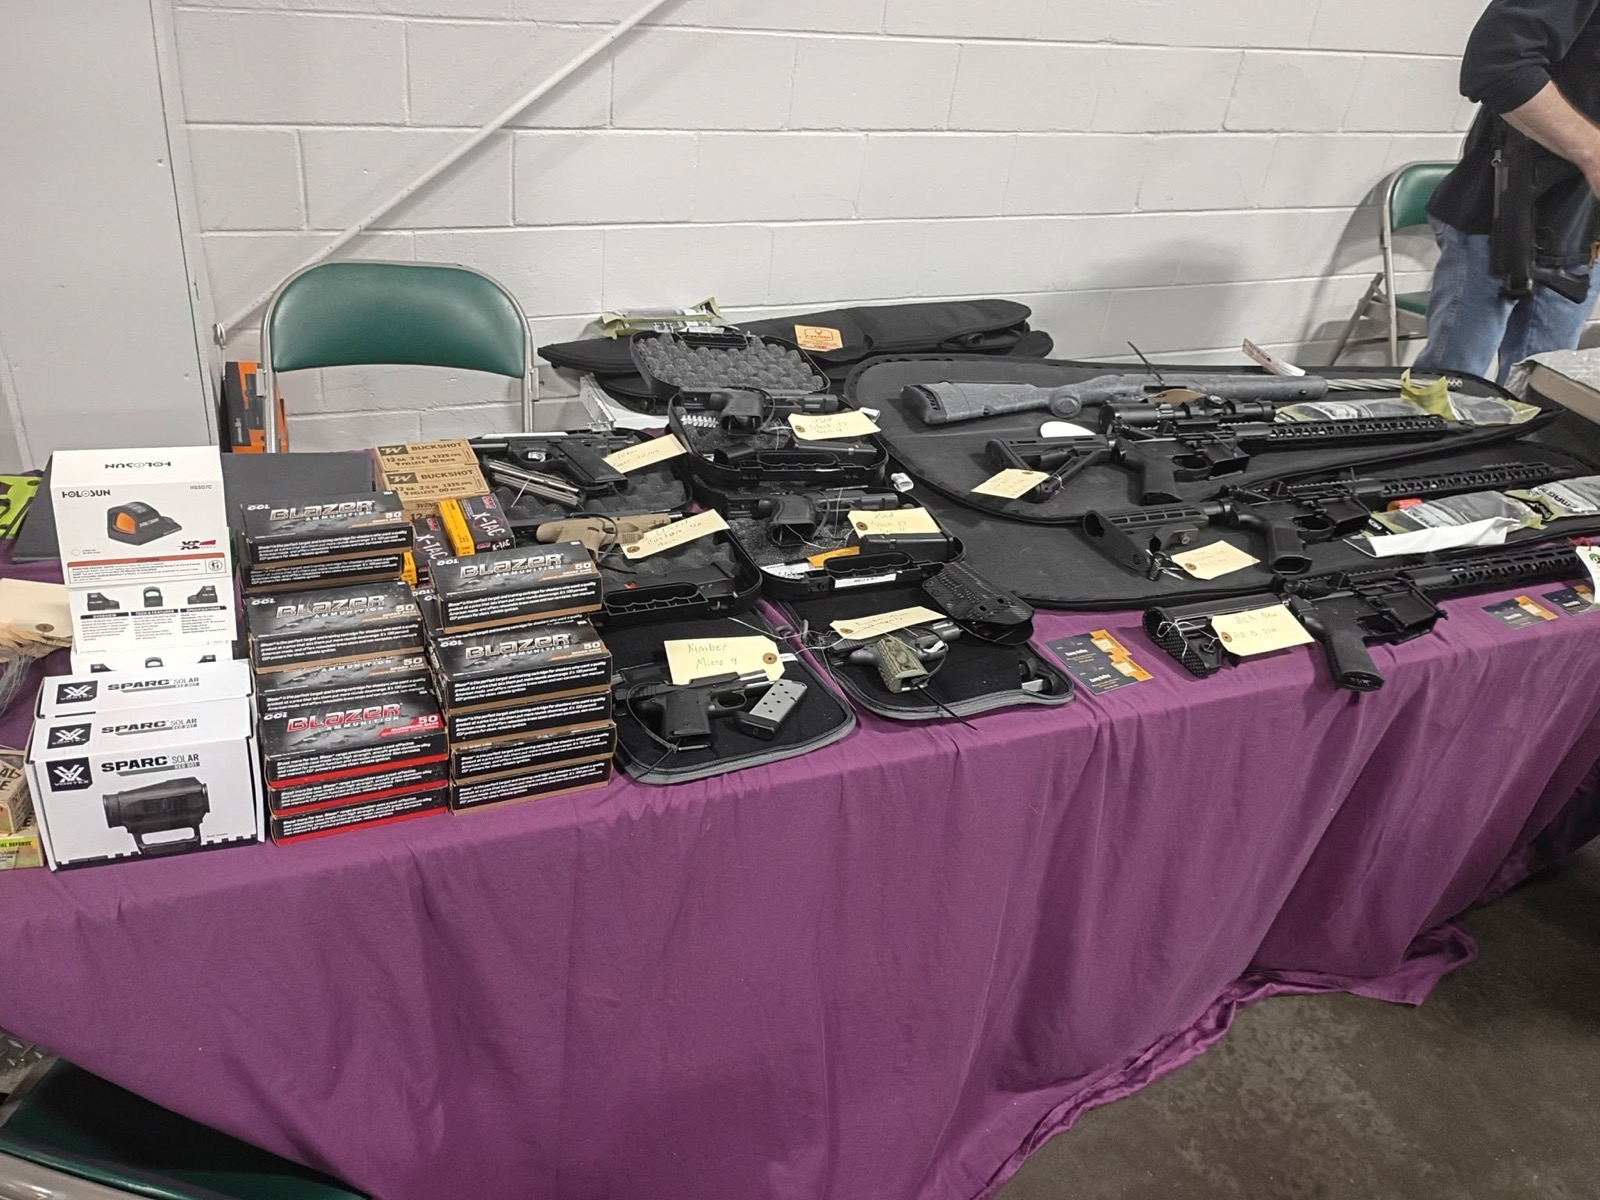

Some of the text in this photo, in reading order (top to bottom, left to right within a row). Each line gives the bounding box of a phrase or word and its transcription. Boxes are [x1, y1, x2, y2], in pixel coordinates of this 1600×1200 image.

[411, 442, 462, 450] BUCKSHOT
[421, 470, 473, 479] BUCKSHOT
[62, 489, 111, 498] HOLOSUN
[270, 500, 374, 520] BLAZER
[306, 511, 372, 521] AMMUNITION
[416, 534, 448, 559] X-TAC
[460, 554, 562, 578] BLAZER
[495, 565, 561, 577] AMMUNITION
[276, 596, 385, 618] BLAZER
[314, 607, 383, 618] AMMUNITION
[465, 634, 570, 660] BLAZER
[502, 645, 570, 658] AMMUNITION
[687, 642, 727, 654] Kimber
[322, 659, 392, 672] AMMUNITION
[108, 679, 169, 690] SPARC
[264, 711, 288, 720] CCI
[287, 704, 400, 732] BLAZER
[102, 720, 166, 733] SPARC
[327, 716, 399, 731] AMMUNITION
[101, 754, 198, 772] SPARC SOLAR
